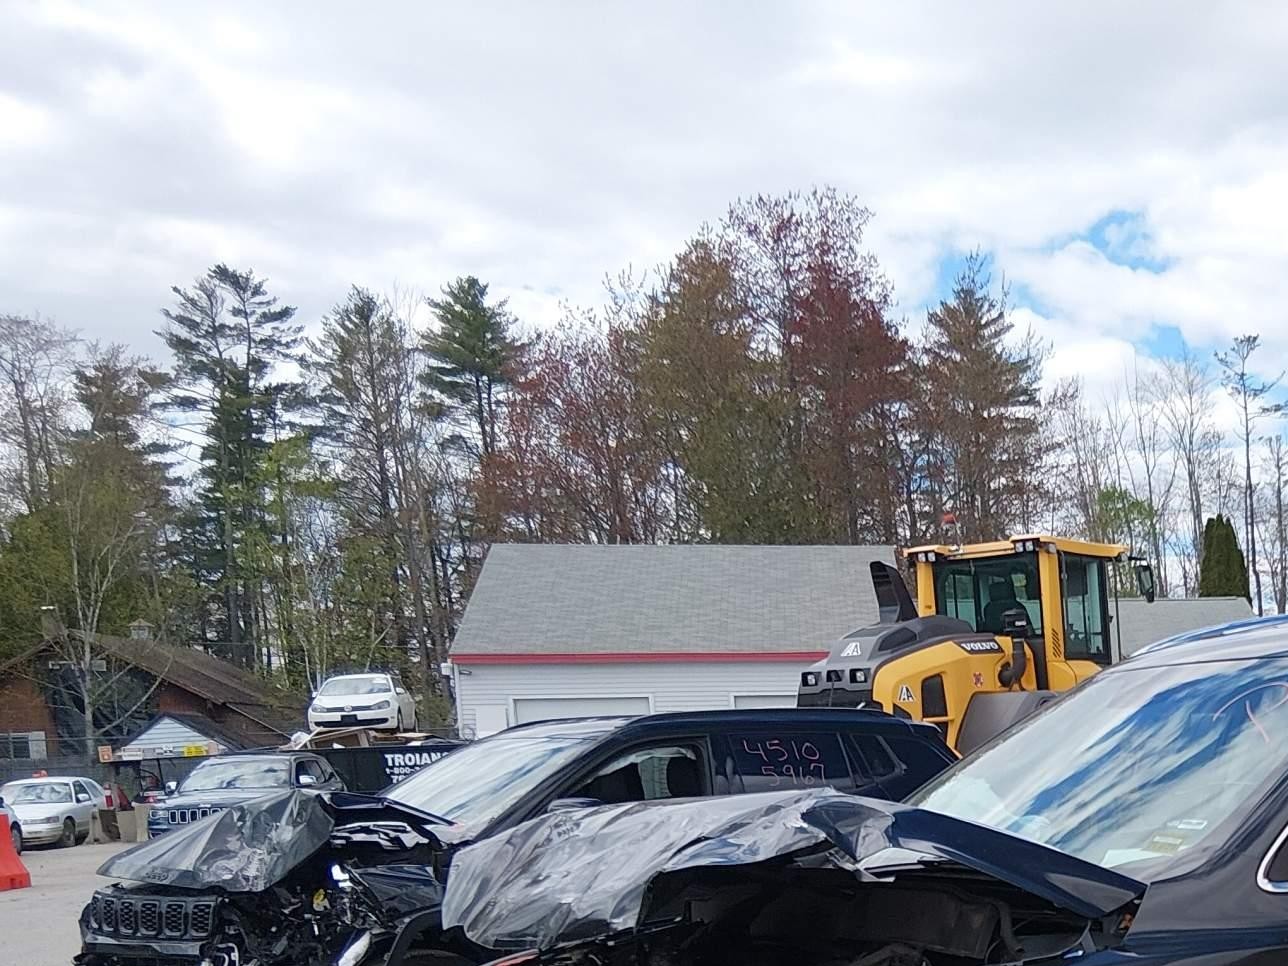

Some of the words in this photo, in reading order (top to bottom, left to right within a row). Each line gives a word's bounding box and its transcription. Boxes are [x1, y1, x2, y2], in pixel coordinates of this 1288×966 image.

[960, 641, 999, 651] VOLVO
[743, 740, 820, 762] 4510
[761, 763, 826, 787] 5967
